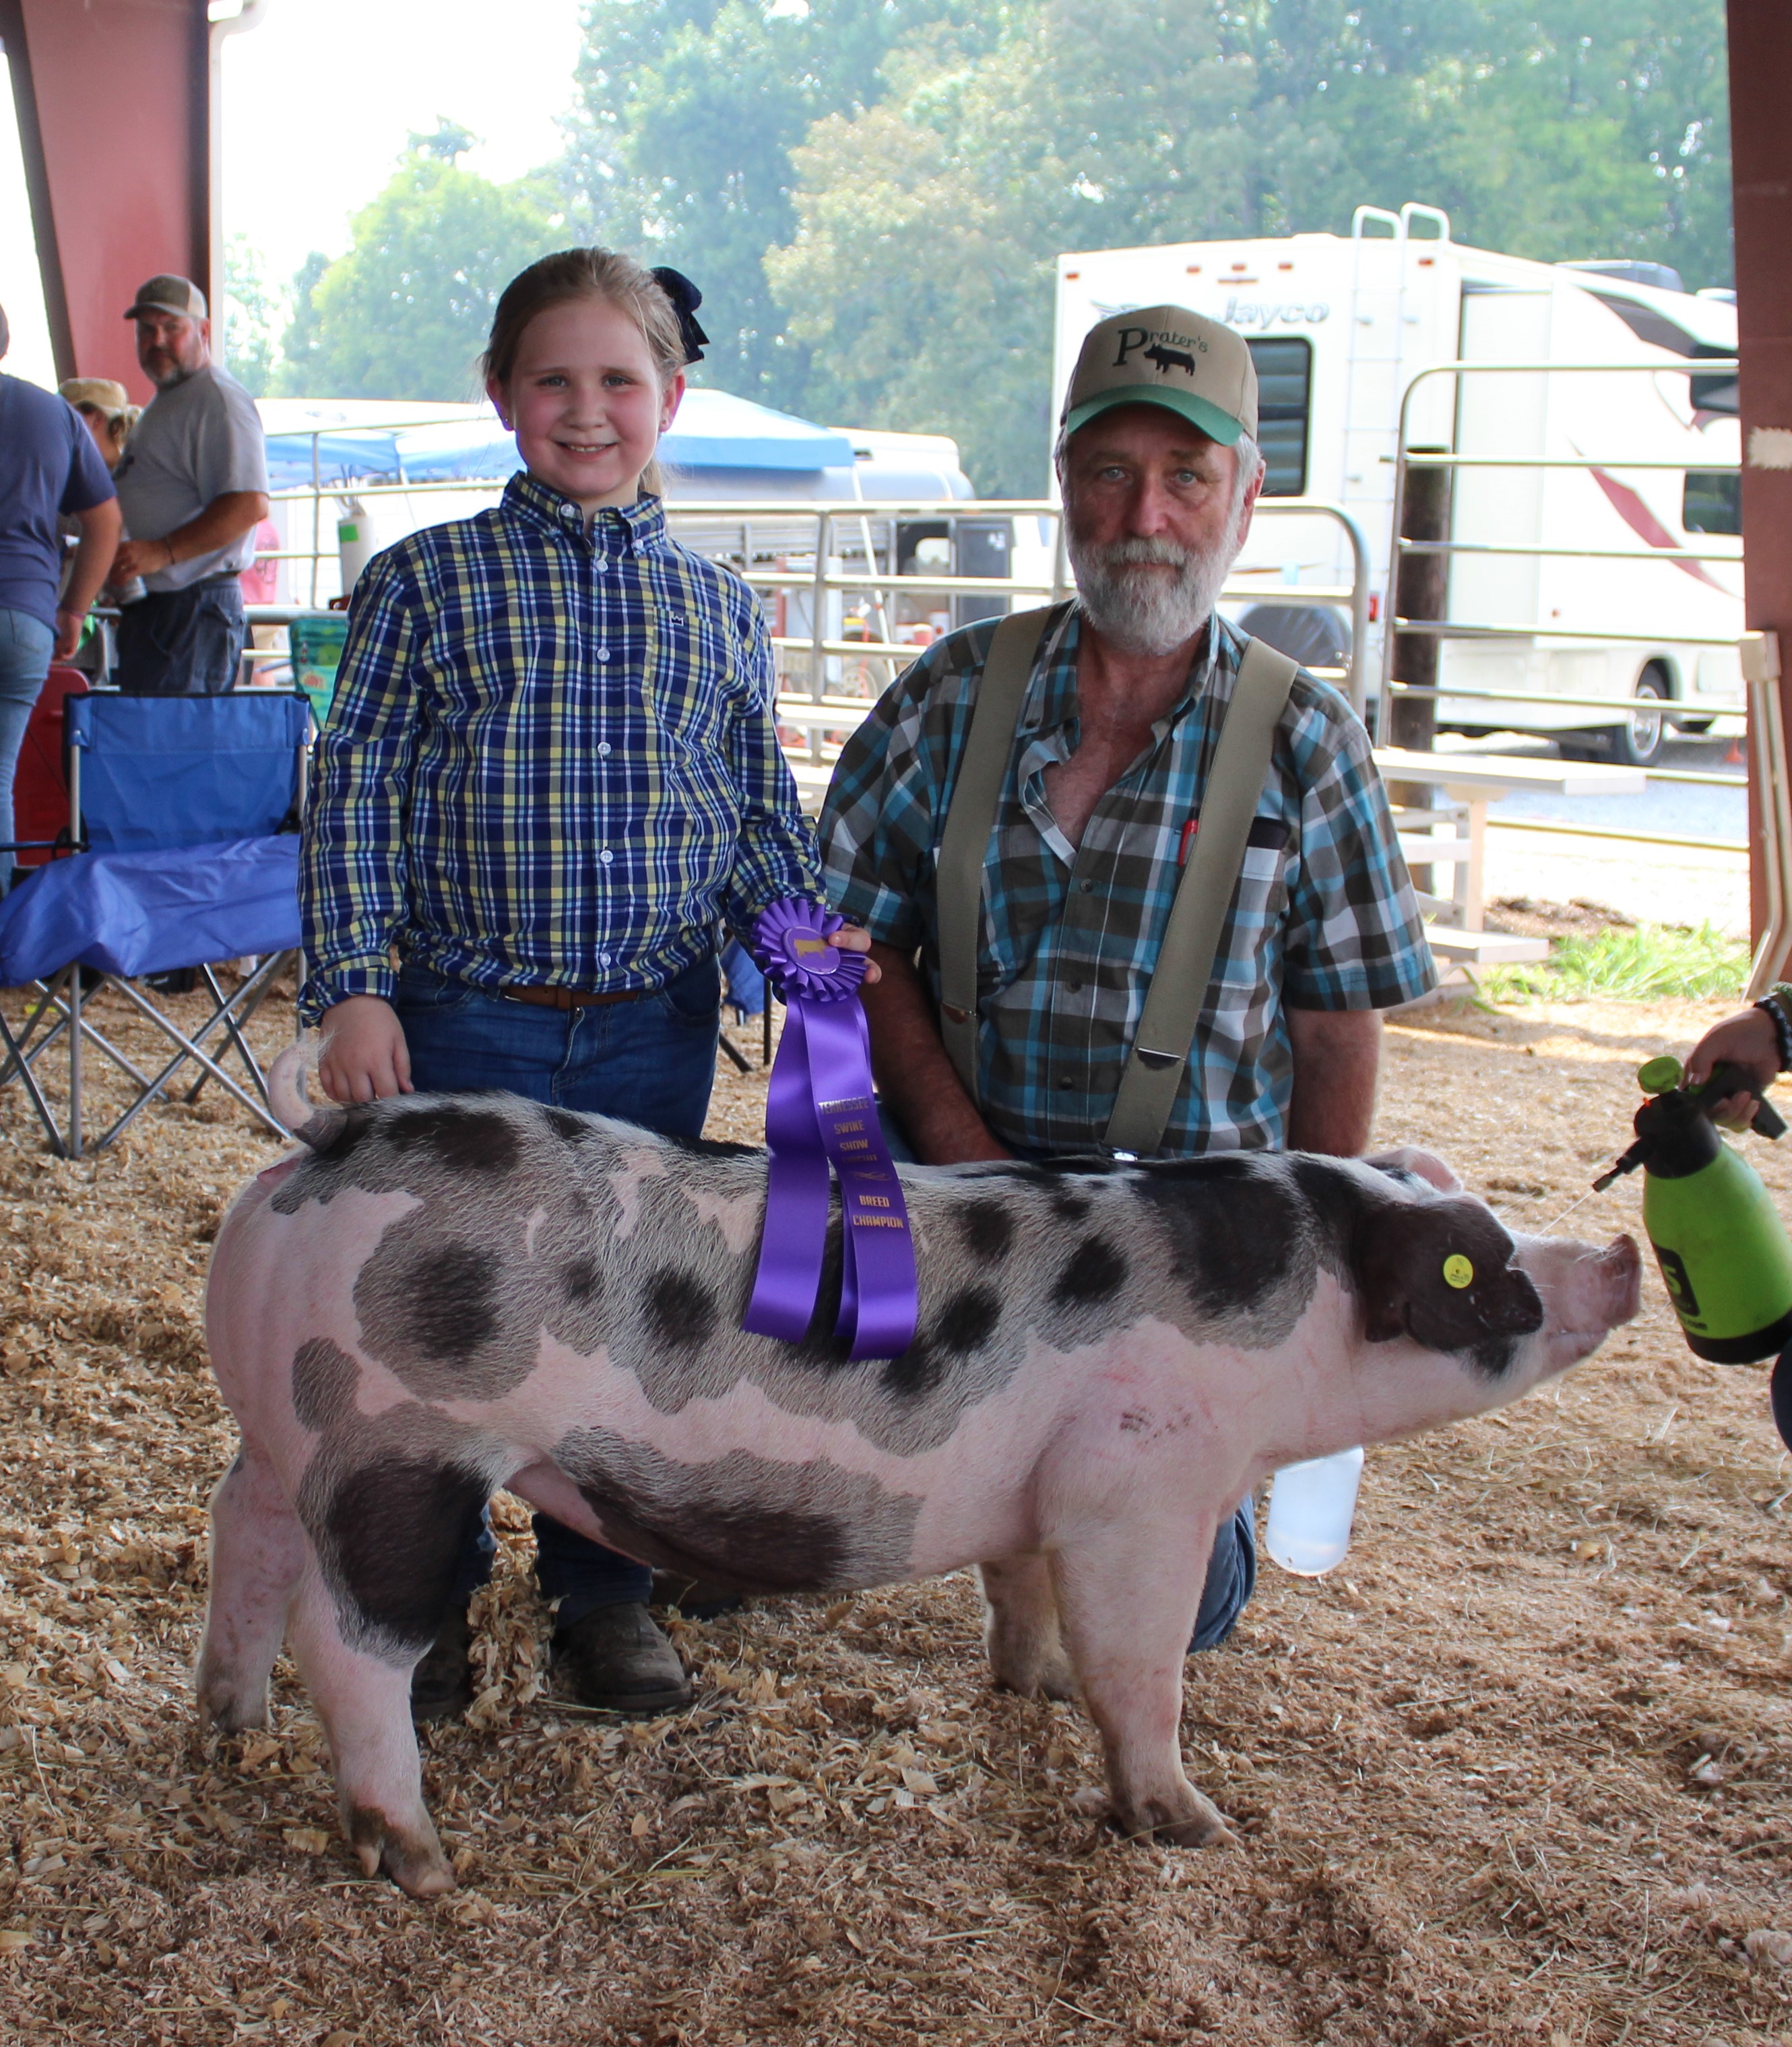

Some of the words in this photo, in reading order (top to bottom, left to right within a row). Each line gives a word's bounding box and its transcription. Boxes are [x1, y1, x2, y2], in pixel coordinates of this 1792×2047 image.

[1217, 296, 1329, 330] Jayco
[1112, 327, 1209, 367] Prater's
[819, 1096, 869, 1114] TENNESSEE
[834, 1120, 865, 1135] SWINE
[839, 1139, 868, 1152] SHOW
[859, 1195, 890, 1207] BREED
[852, 1214, 904, 1229] CHAMPION
